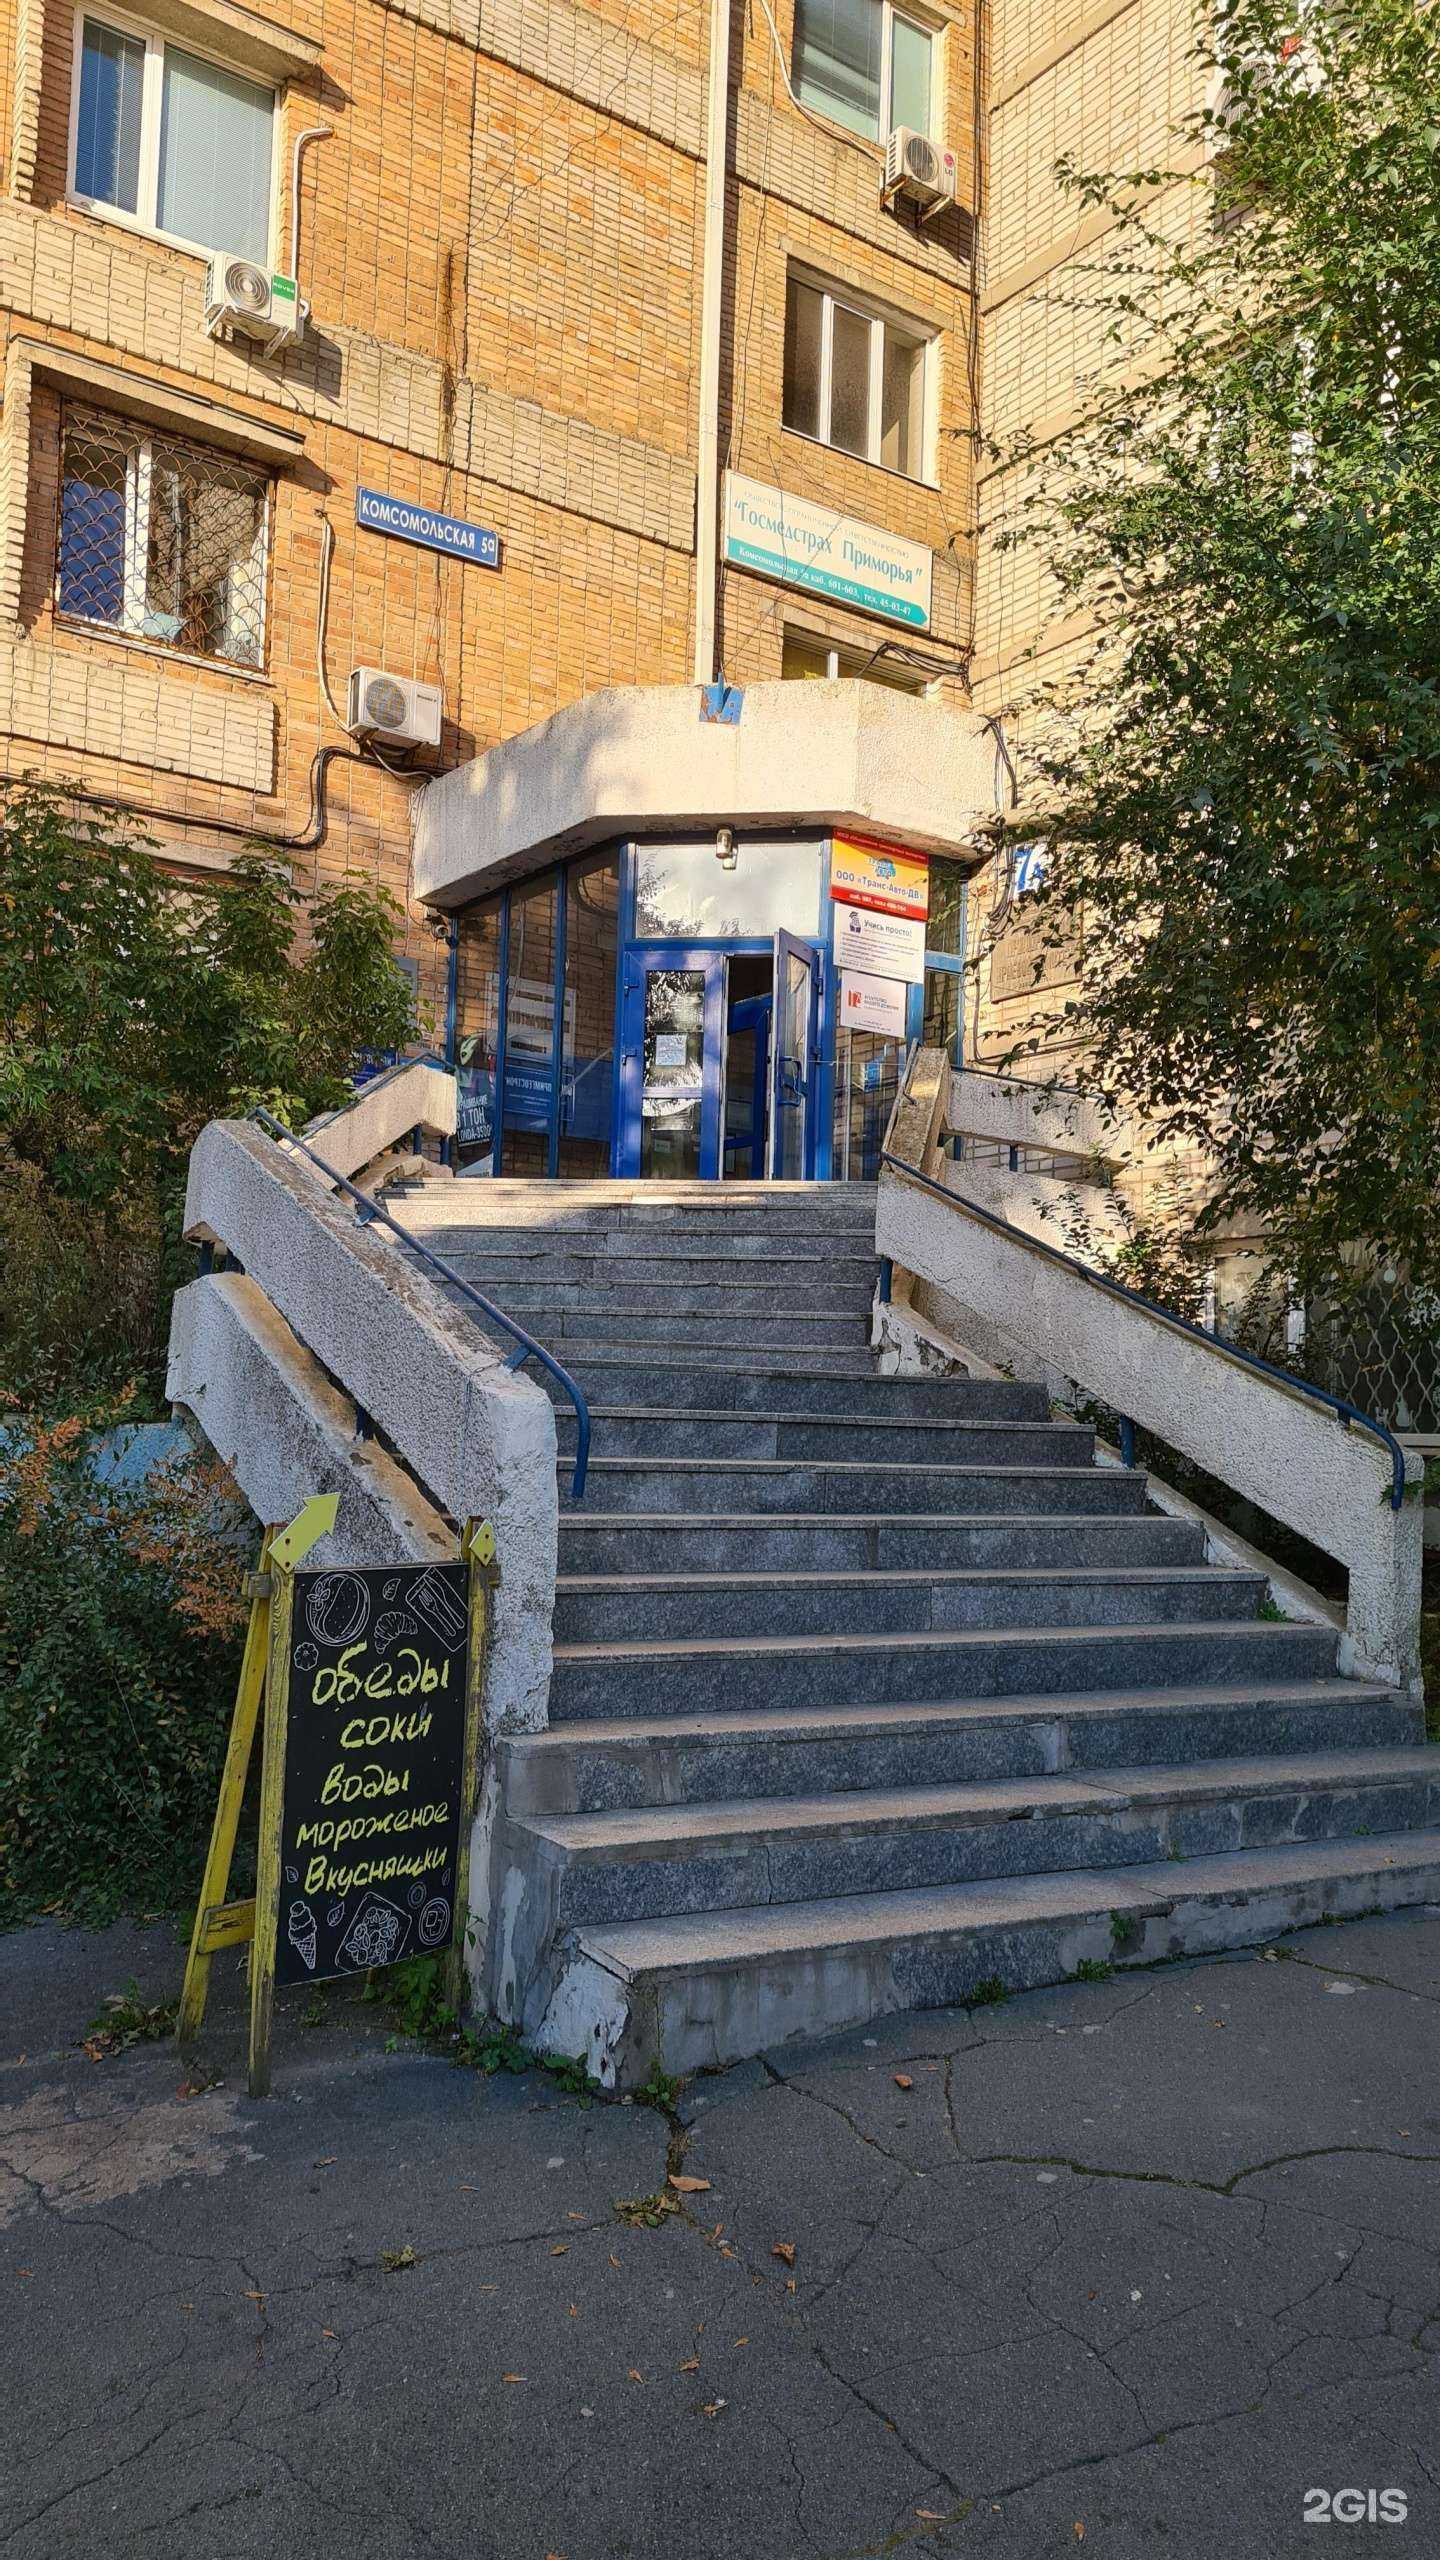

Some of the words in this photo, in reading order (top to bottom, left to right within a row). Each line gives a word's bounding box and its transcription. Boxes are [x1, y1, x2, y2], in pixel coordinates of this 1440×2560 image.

[362, 496, 475, 550] КОМСОМОЛЬСКАЯ
[836, 870, 855, 882] ООО
[468, 1106, 485, 1126] ТОН
